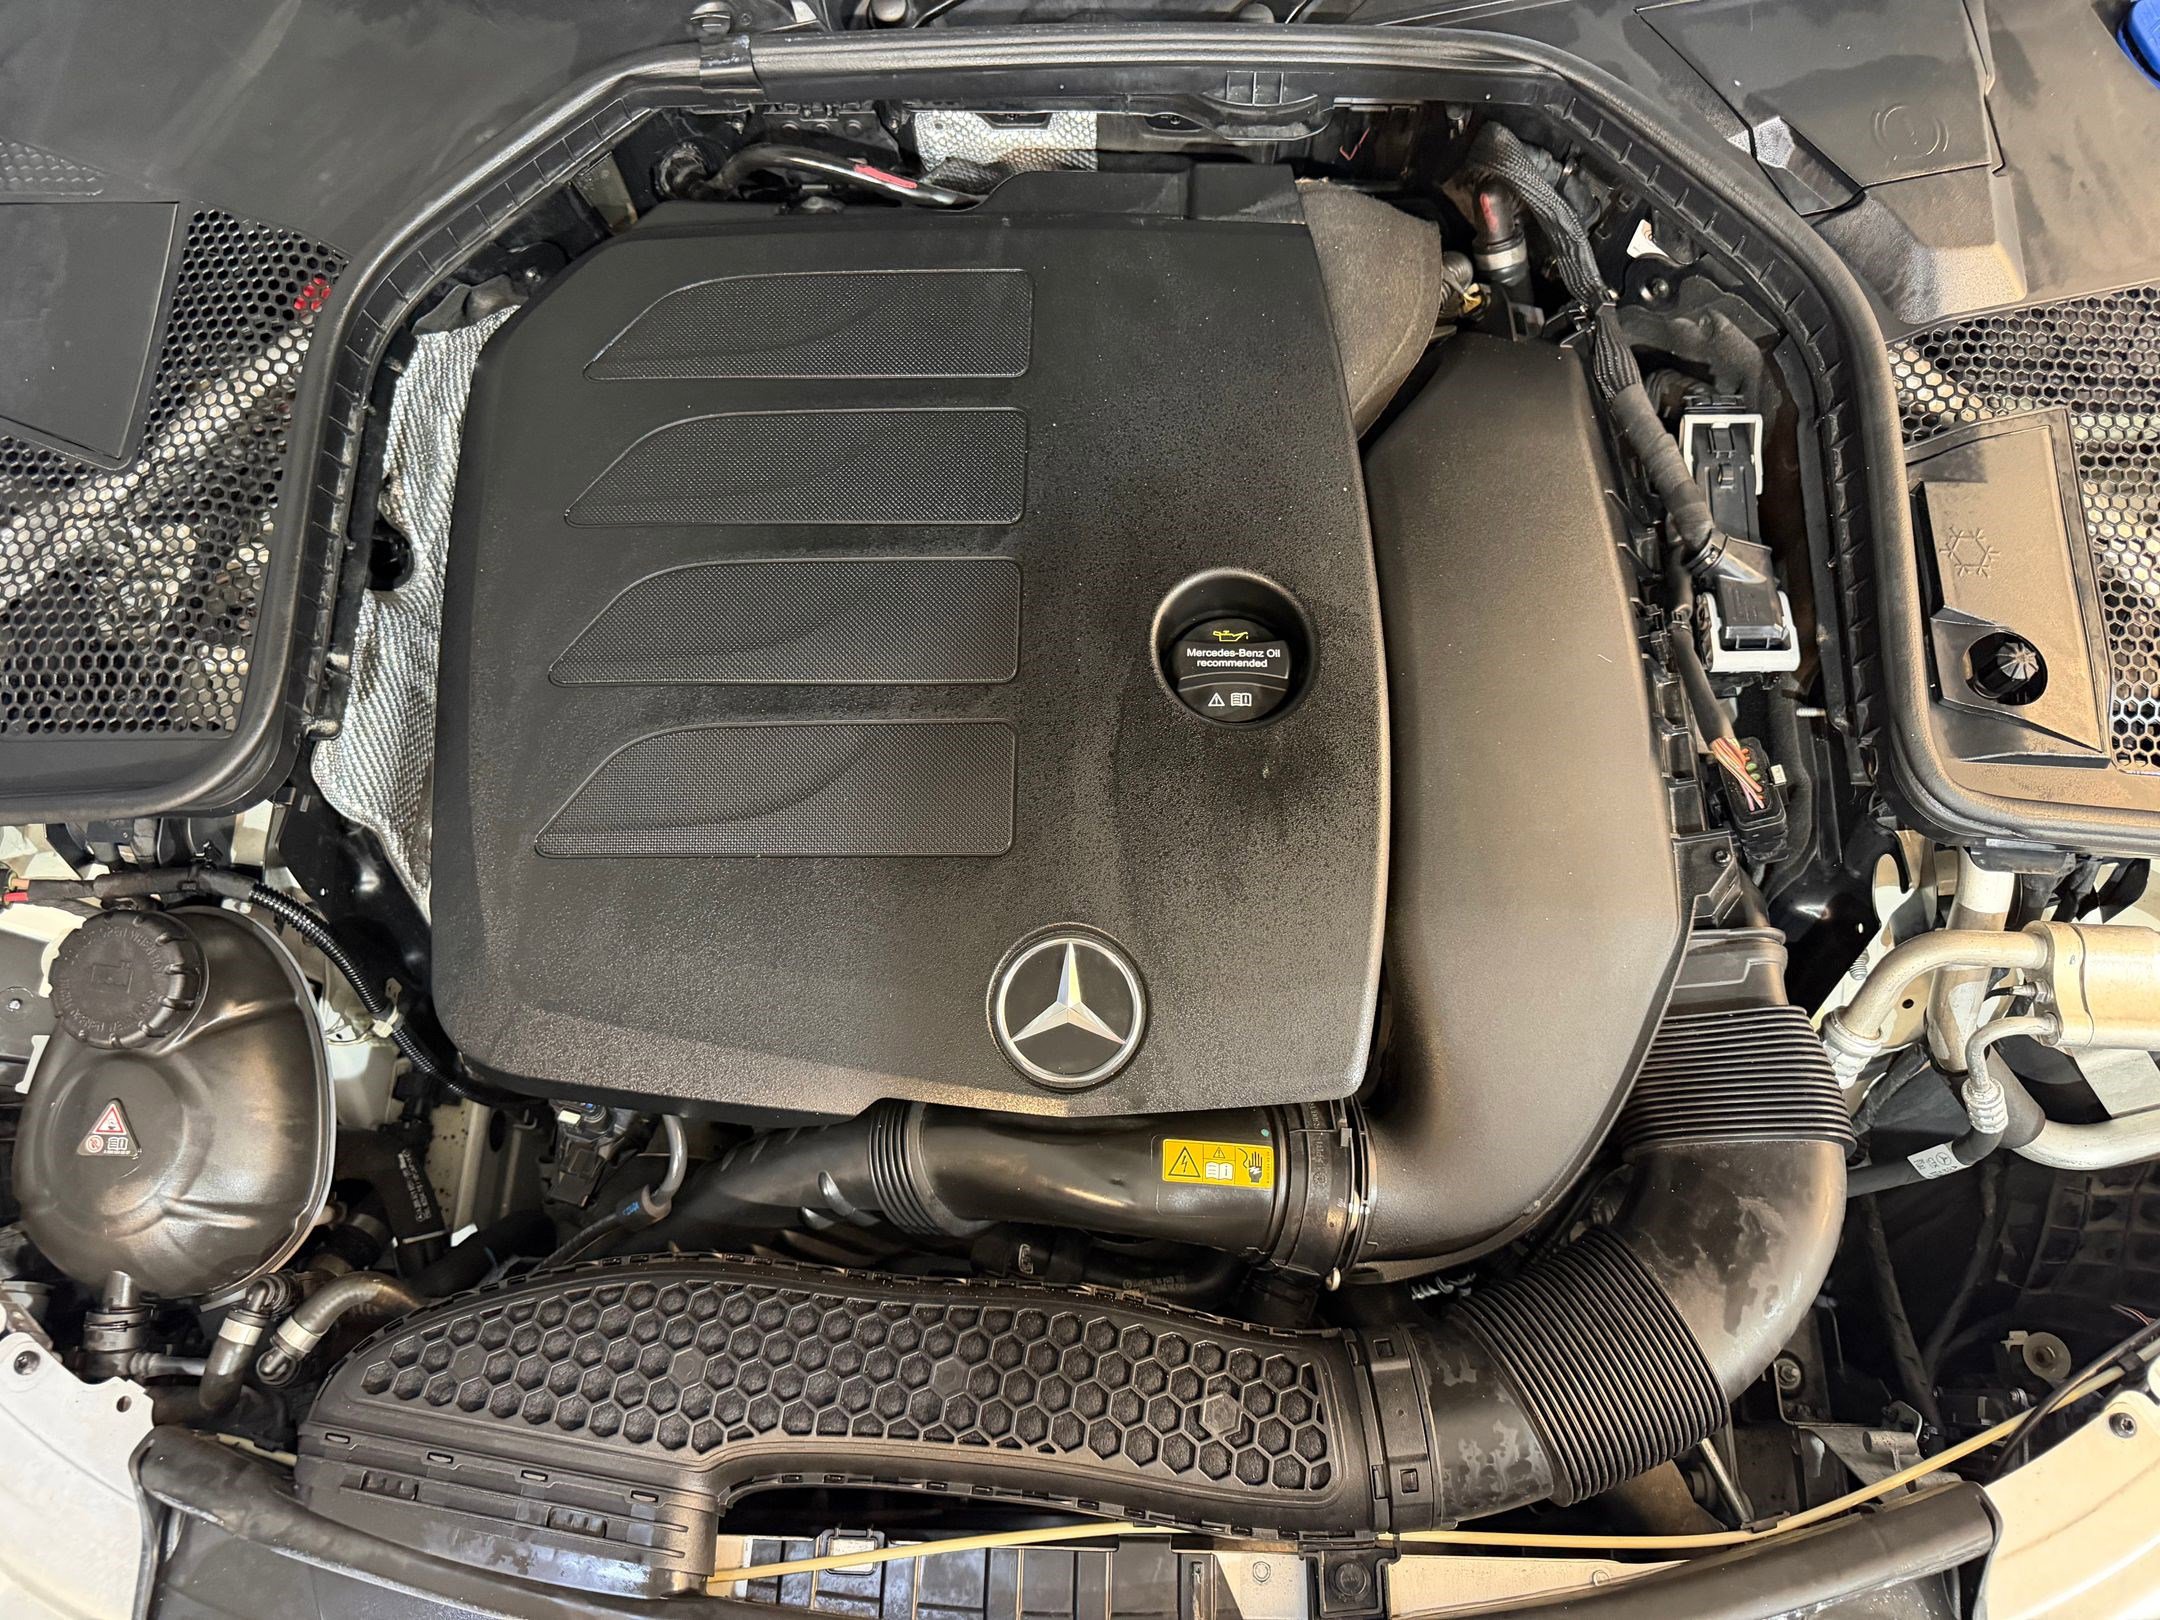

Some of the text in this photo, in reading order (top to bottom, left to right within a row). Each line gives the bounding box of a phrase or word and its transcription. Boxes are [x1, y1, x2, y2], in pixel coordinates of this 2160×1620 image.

[1186, 648, 1281, 658] Mercedes-Benz Oil
[1196, 658, 1268, 668] recommended
